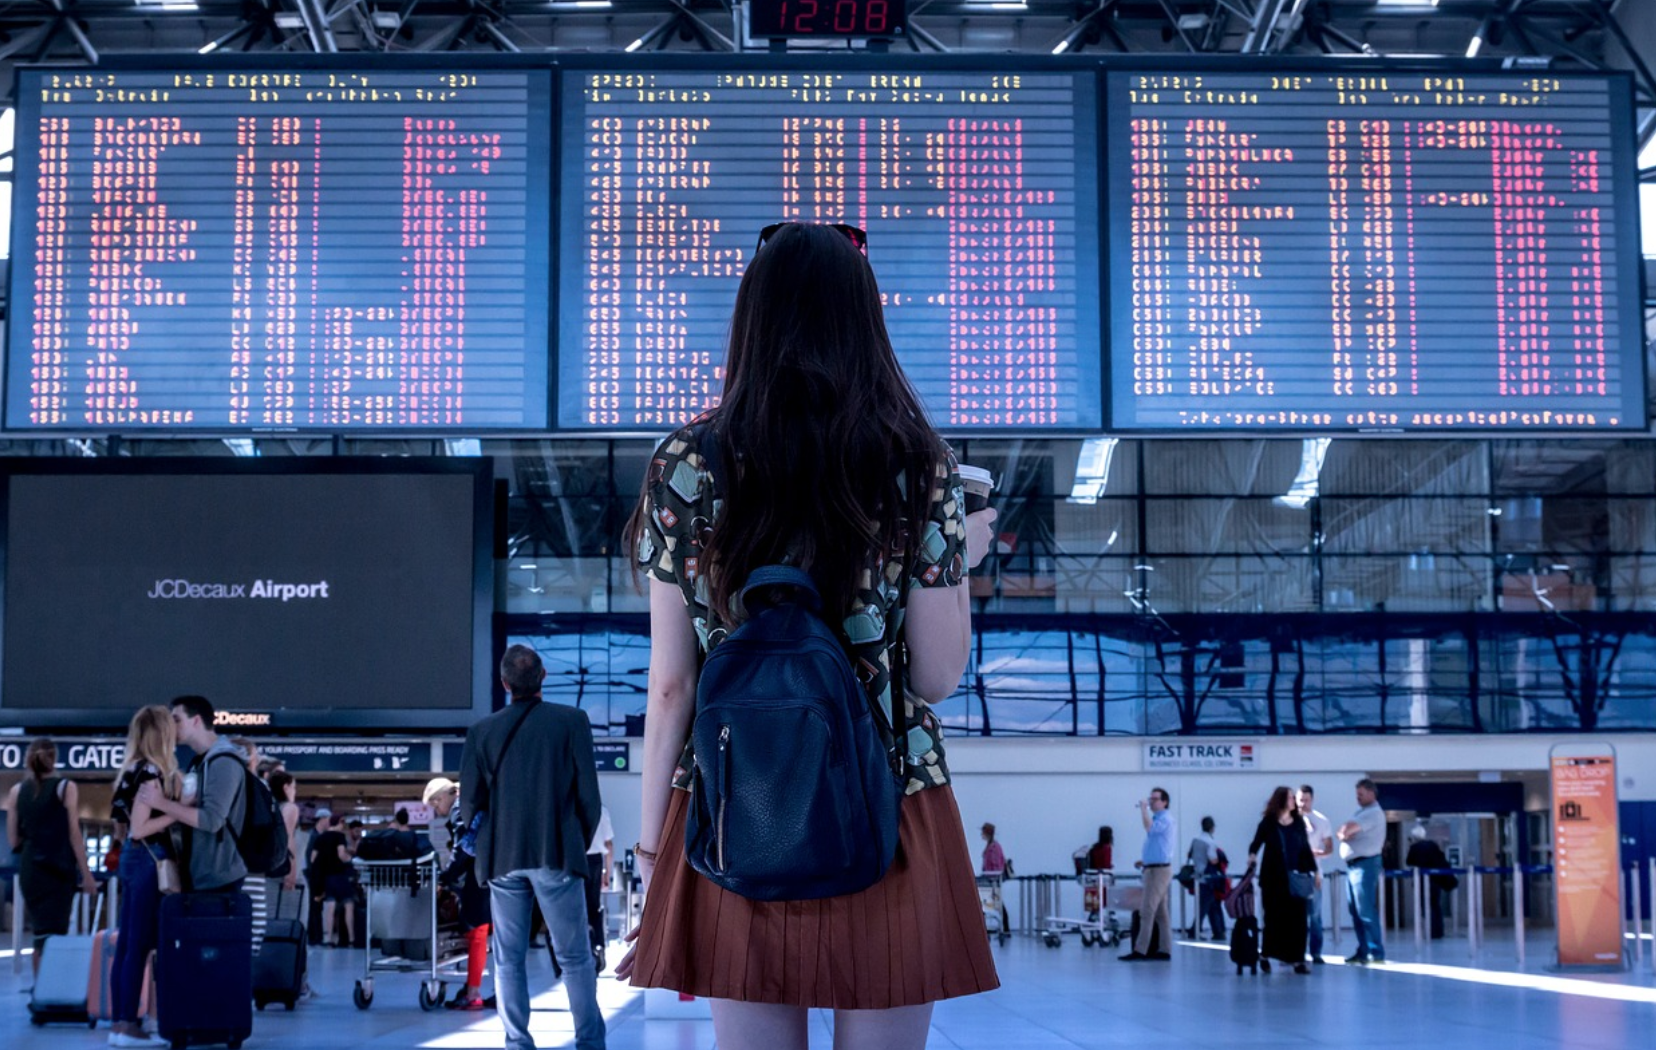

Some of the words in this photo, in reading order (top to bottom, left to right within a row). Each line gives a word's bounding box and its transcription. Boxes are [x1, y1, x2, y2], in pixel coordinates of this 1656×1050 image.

[780, 0, 888, 32] 12:08
[148, 579, 246, 599] JCDecaux
[250, 580, 329, 602] Airport
[0, 744, 20, 769] O
[68, 745, 125, 769] GATE
[284, 746, 317, 754] PASSPORT
[318, 746, 333, 754] AND
[334, 746, 368, 754] BOARDING
[369, 746, 386, 754] PASS
[386, 746, 410, 754] READY
[1149, 745, 1183, 758] FAST
[1187, 745, 1233, 758] TRACK
